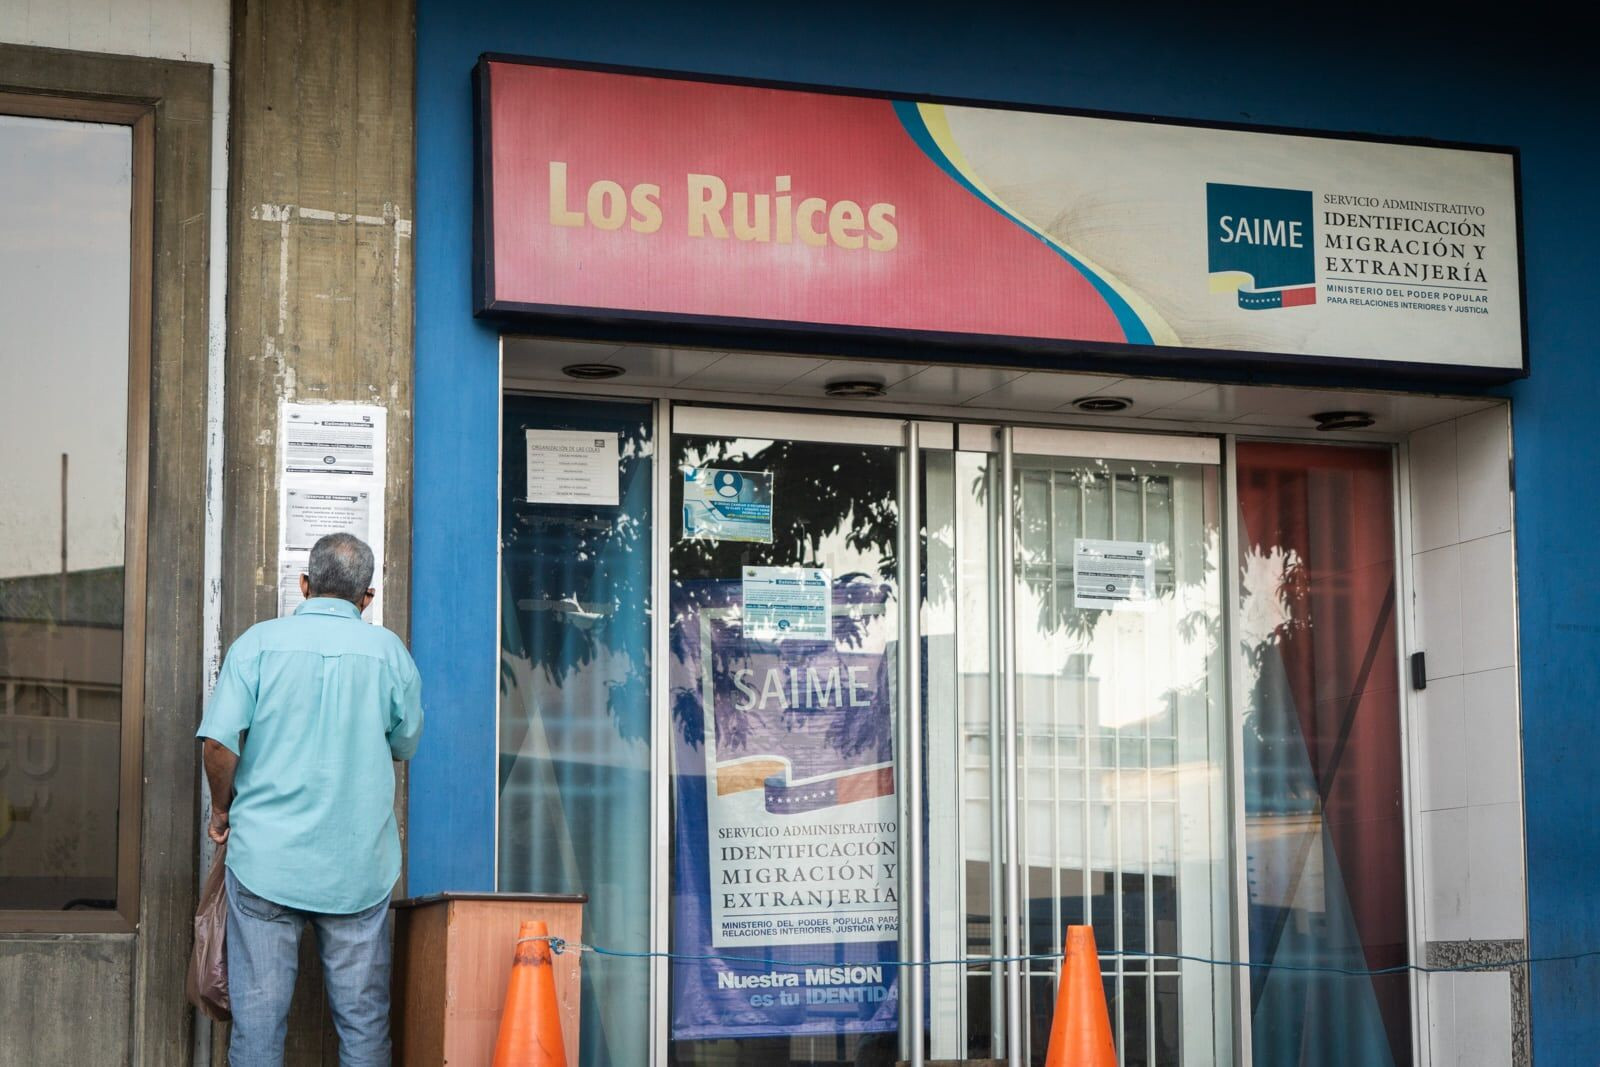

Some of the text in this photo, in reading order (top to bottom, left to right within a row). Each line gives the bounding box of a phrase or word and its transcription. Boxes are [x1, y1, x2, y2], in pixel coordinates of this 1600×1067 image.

[548, 161, 899, 252] Los Ruices
[1323, 193, 1485, 217] SERVICIO ADMINISTRATIVO
[1219, 215, 1304, 249] SAIME
[1323, 211, 1486, 238] IDENTIFICACIÓN
[1324, 233, 1487, 260] MIGRACIÓN Y
[1325, 256, 1488, 283] EXTRANJERÍA
[1326, 284, 1488, 303] MINISTERIO DEL PODER POPULAR
[1327, 296, 1349, 305] PARA
[1349, 298, 1399, 308] RELACIONES
[1400, 302, 1446, 312] INTERIORES
[1454, 305, 1488, 315] JUSTICIA
[734, 666, 871, 712] SAIME
[718, 822, 896, 839] SERVICIO ADMINISTRATIVO
[721, 837, 896, 861] IDENTIFICACIÓN
[721, 859, 897, 885] MIGRACIÓN Y
[723, 882, 897, 909] EXTRANJERÍA
[722, 920, 773, 930] MINISTERIO
[776, 919, 794, 928] DEL
[798, 918, 829, 927] PODER
[832, 916, 874, 926] POPULAR
[722, 928, 778, 937] RELACIONES
[836, 924, 875, 933] JUSTICIA
[717, 970, 800, 990] Nuestra
[750, 993, 774, 1008] es
[779, 990, 800, 1006] tu
